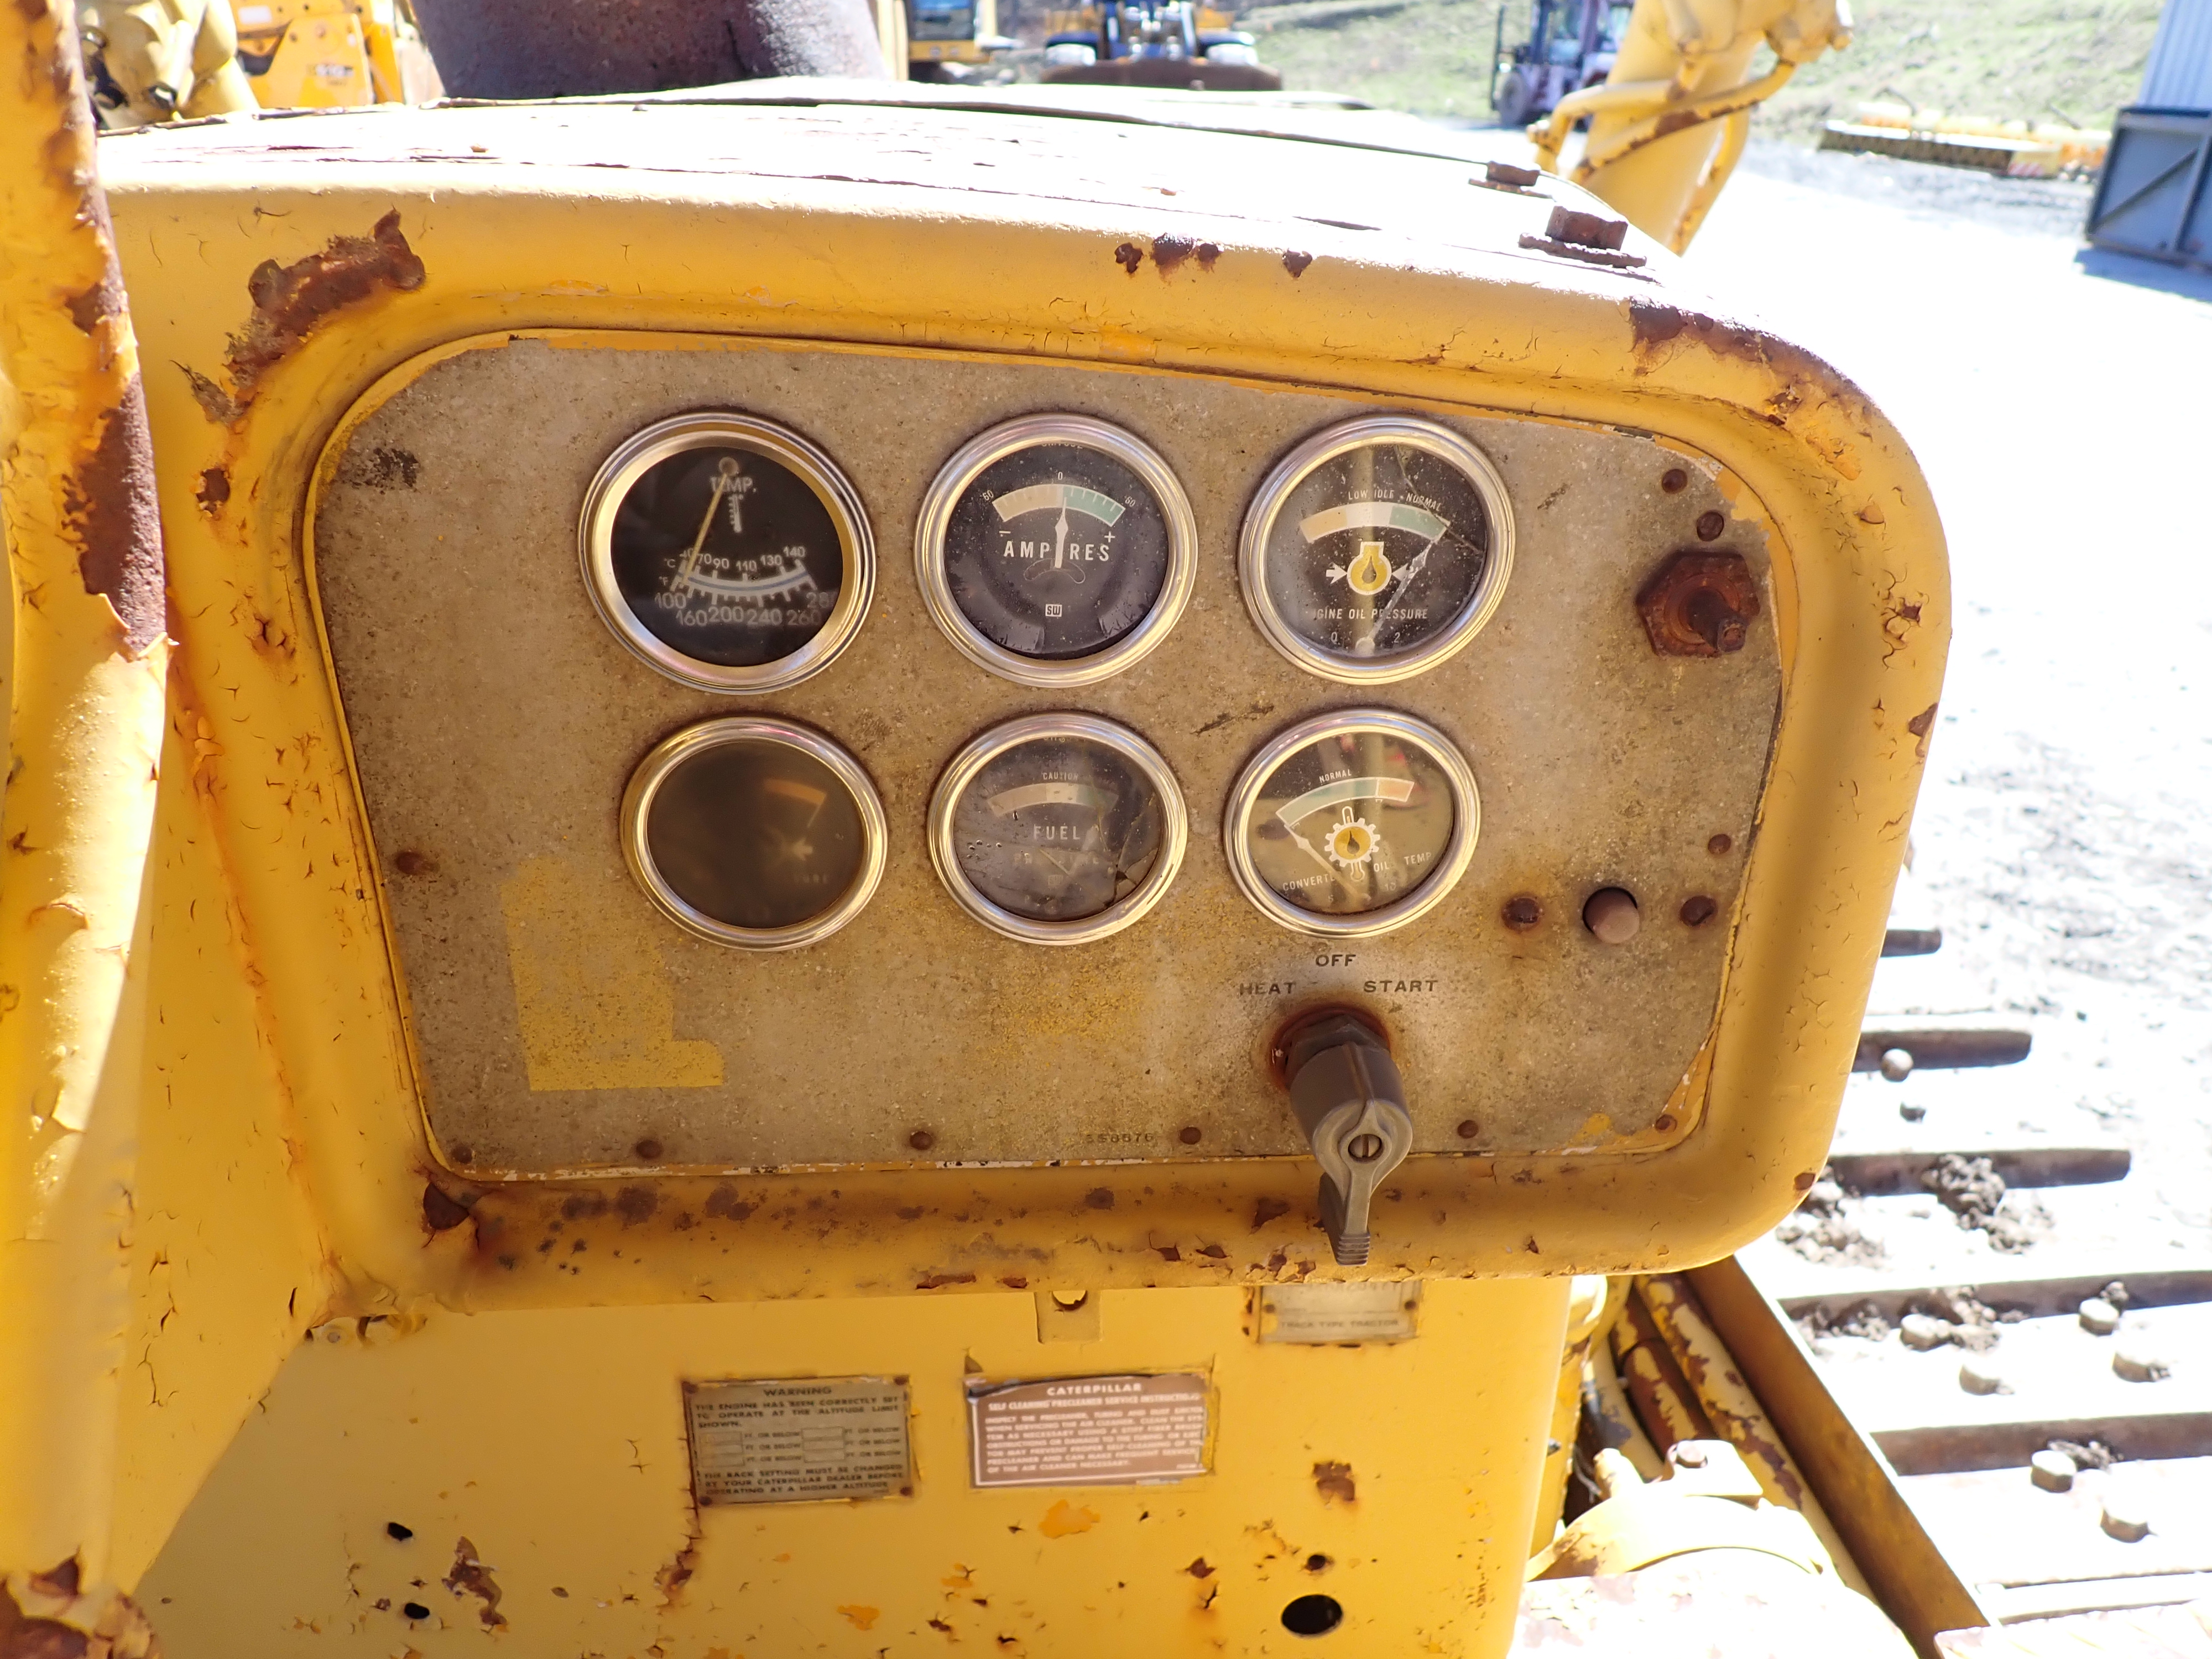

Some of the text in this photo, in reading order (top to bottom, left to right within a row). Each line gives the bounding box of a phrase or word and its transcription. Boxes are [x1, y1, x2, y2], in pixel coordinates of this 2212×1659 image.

[1057, 471, 1063, 480] 0
[982, 490, 994, 502] 60
[1348, 490, 1368, 500] LOW
[1374, 489, 1394, 498] IDLE
[1125, 496, 1136, 508] 60
[782, 546, 806, 558] 140
[1004, 541, 1109, 561] AMPRES
[697, 554, 782, 571] 70 90 110 130
[654, 592, 687, 609] 100
[676, 610, 708, 627] 160
[708, 606, 744, 623] 200
[747, 608, 783, 625] 240
[806, 592, 834, 608] 28
[1349, 609, 1366, 619] OIL
[1319, 769, 1352, 784] NORMAL
[1034, 826, 1081, 840] FUEL
[1282, 852, 1432, 891] CONVERTE OIL TEMP
[1315, 954, 1356, 967] OFF
[1239, 980, 1438, 995] HEAT START
[763, 1386, 831, 1396] WARNING
[1047, 1383, 1142, 1396] CATERPILLAR
[988, 1402, 1007, 1411] SELF
